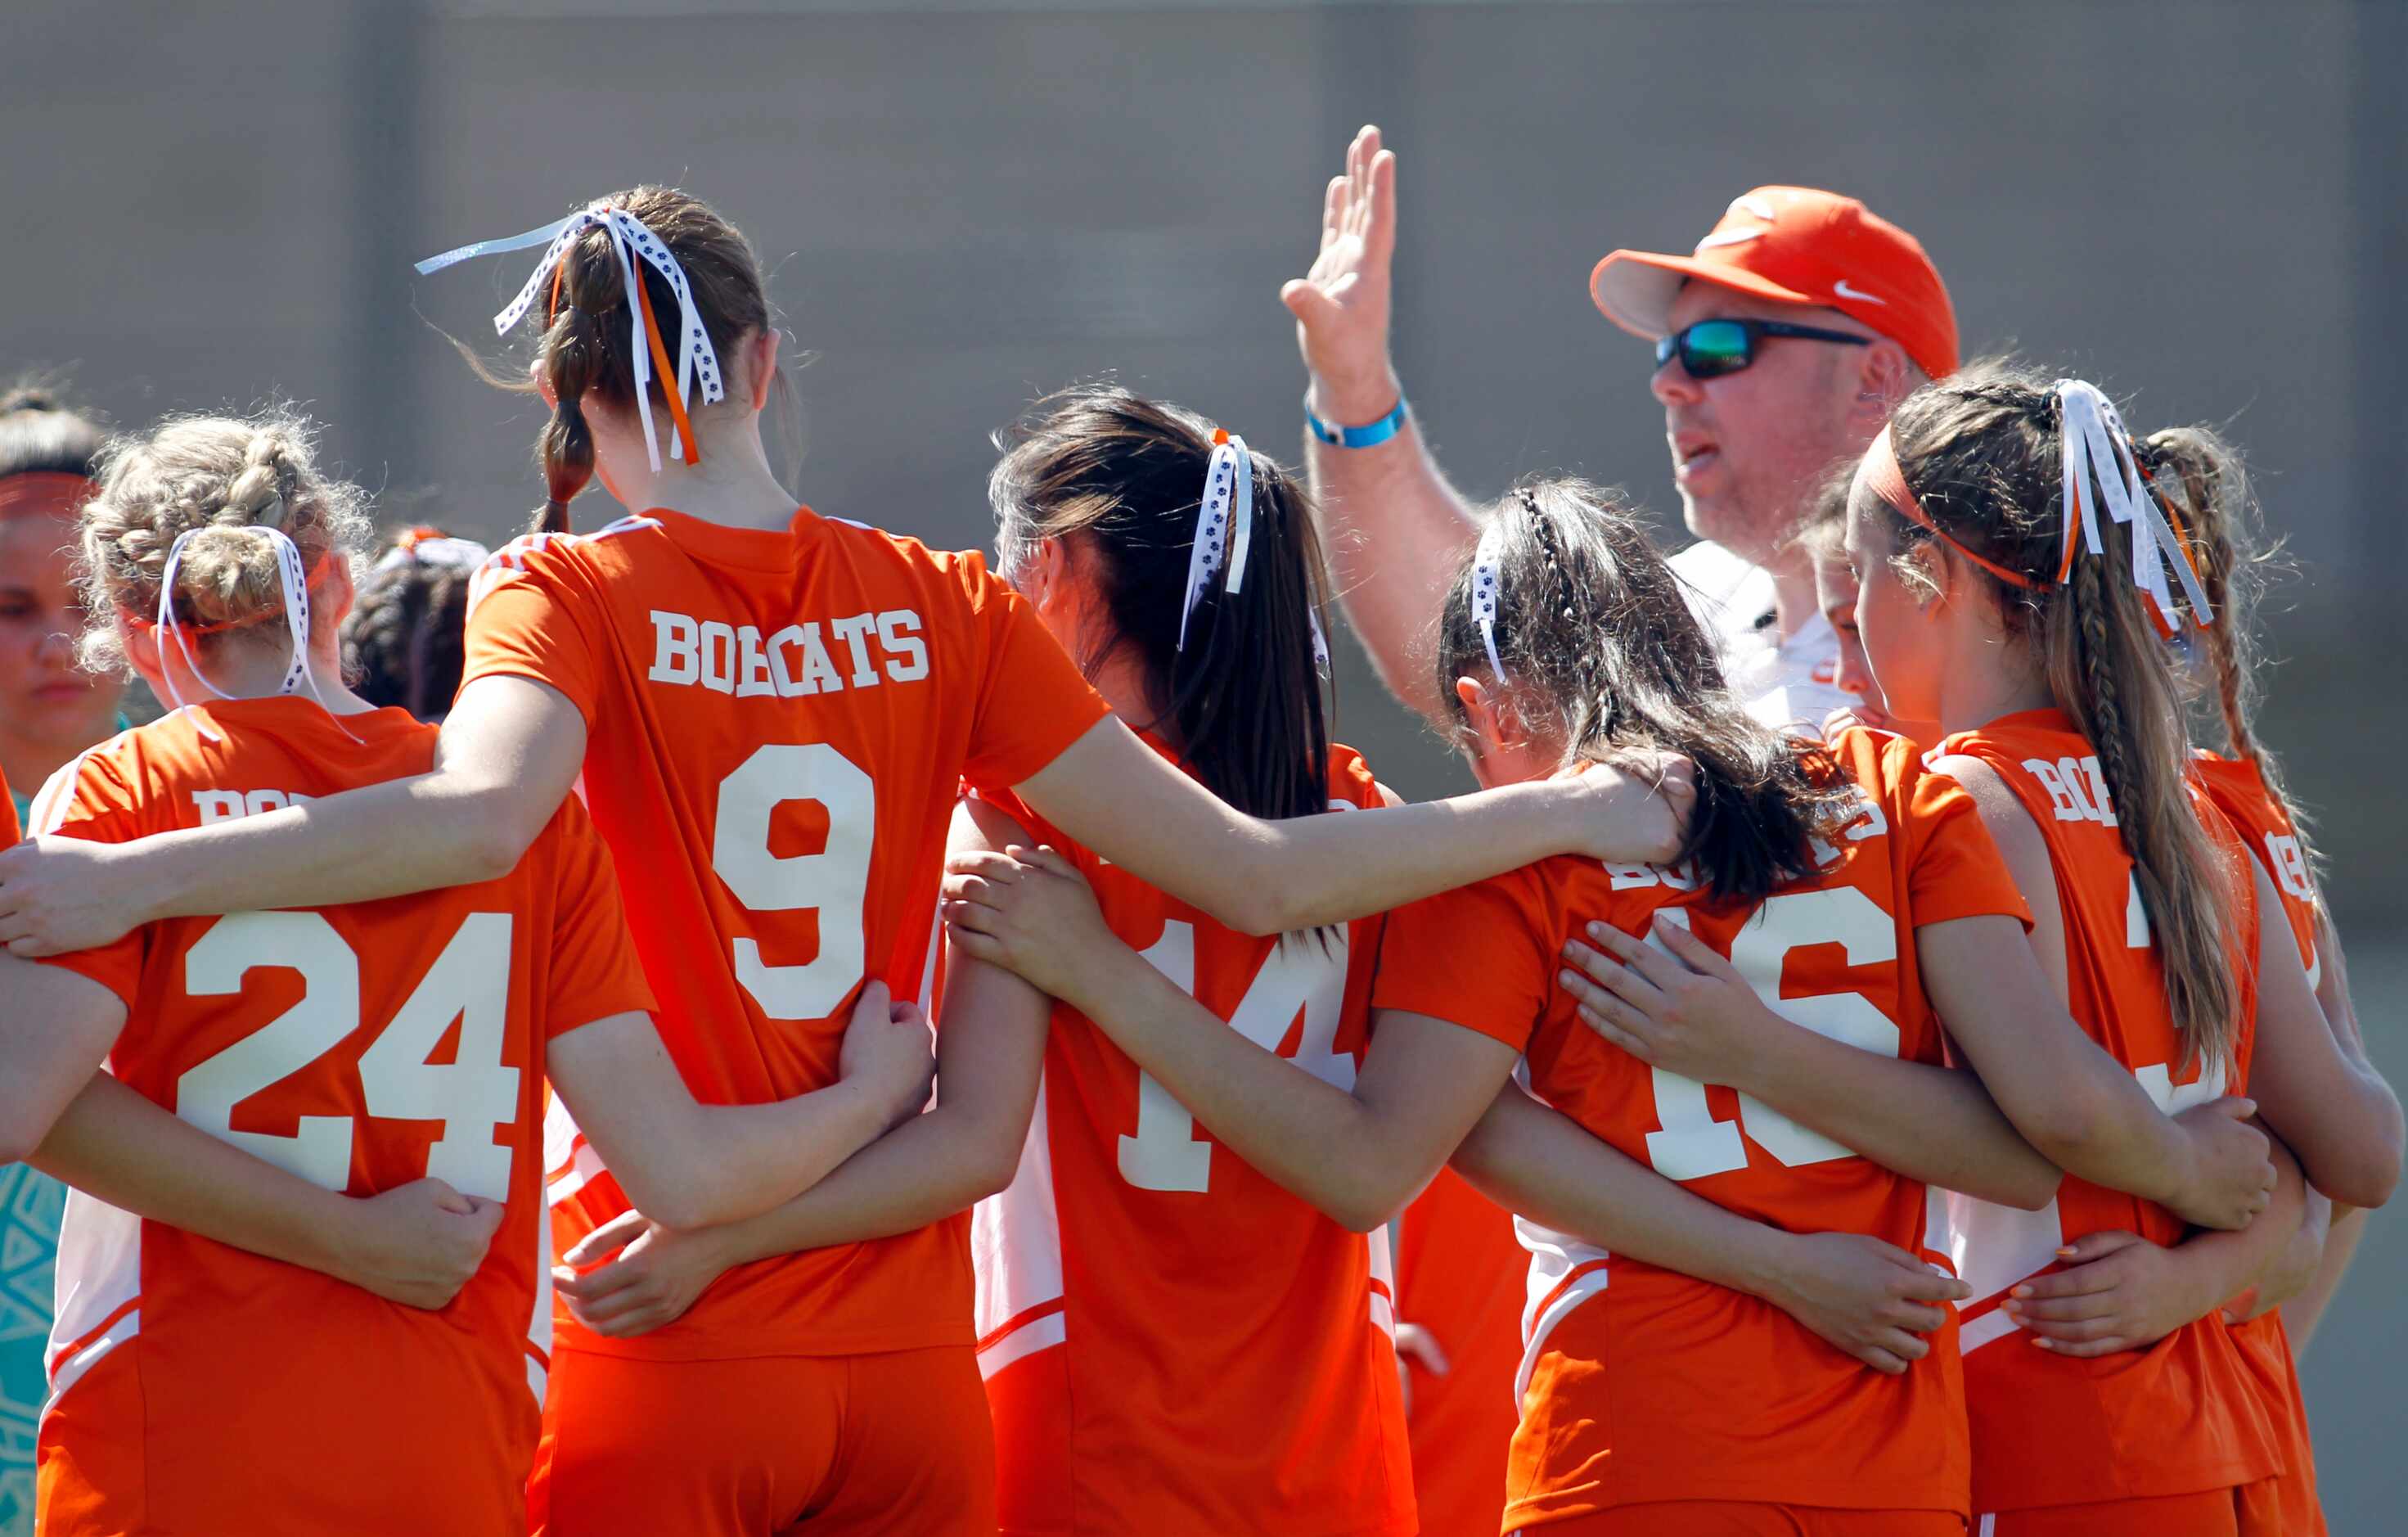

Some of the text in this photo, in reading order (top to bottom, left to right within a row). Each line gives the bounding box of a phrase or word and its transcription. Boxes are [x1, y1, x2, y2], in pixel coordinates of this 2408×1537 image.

[648, 609, 930, 698] BOBCATS
[712, 742, 875, 1021] 9
[176, 910, 520, 1204] 24
[1118, 918, 1357, 1193] 14
